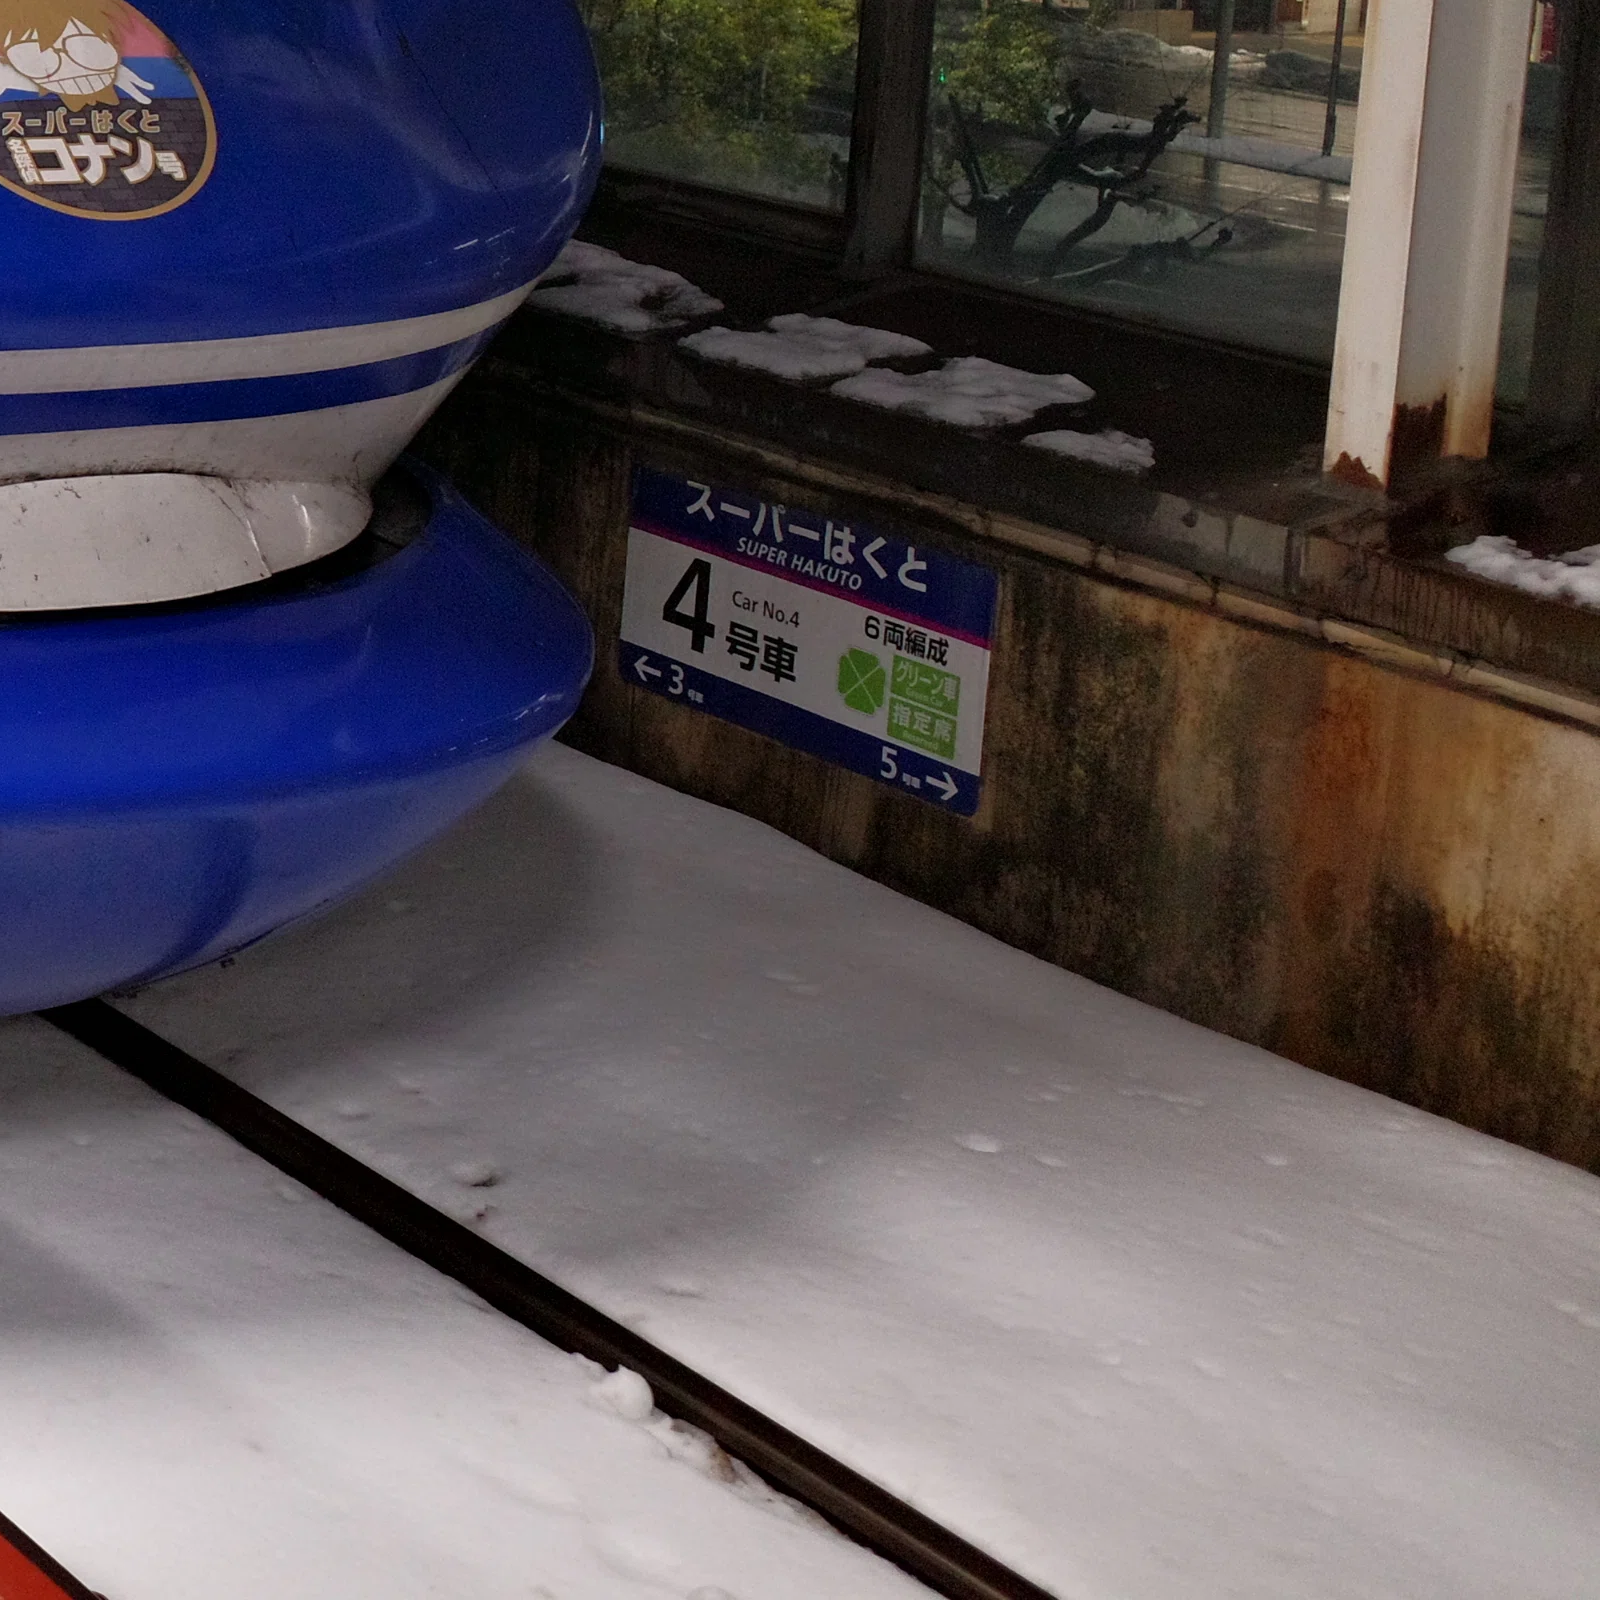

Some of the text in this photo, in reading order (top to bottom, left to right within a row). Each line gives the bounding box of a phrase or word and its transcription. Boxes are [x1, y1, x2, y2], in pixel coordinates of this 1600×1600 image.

[2, 106, 161, 135] スーパーはくと
[687, 480, 927, 593] スーパーはくと
[737, 537, 862, 590] SUPER HAKUTO
[732, 591, 800, 628] Car No.4
[864, 615, 949, 667] 6両編成
